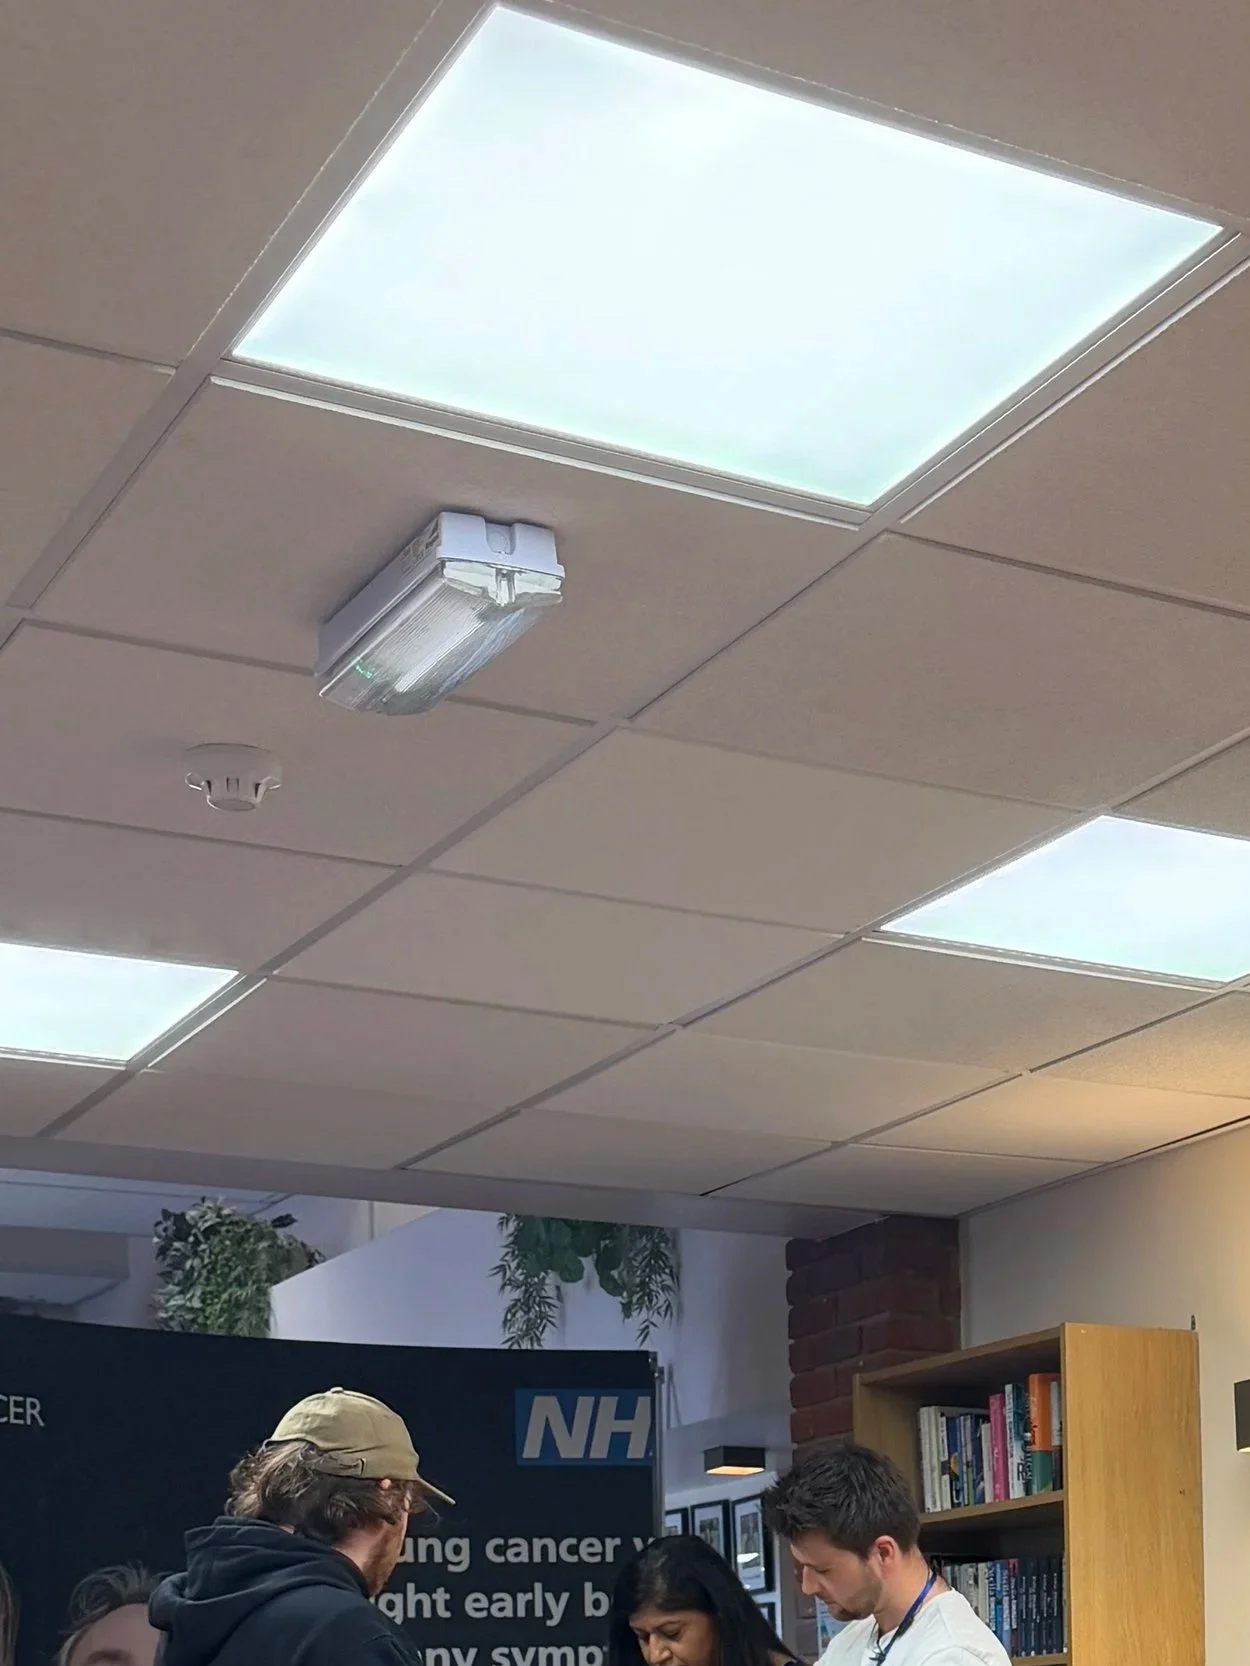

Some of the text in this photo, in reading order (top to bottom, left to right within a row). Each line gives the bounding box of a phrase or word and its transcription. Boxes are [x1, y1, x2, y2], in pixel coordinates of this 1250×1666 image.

[522, 1395, 654, 1459] NH
[485, 1536, 621, 1564] cancer
[372, 1581, 613, 1627] ght early b
